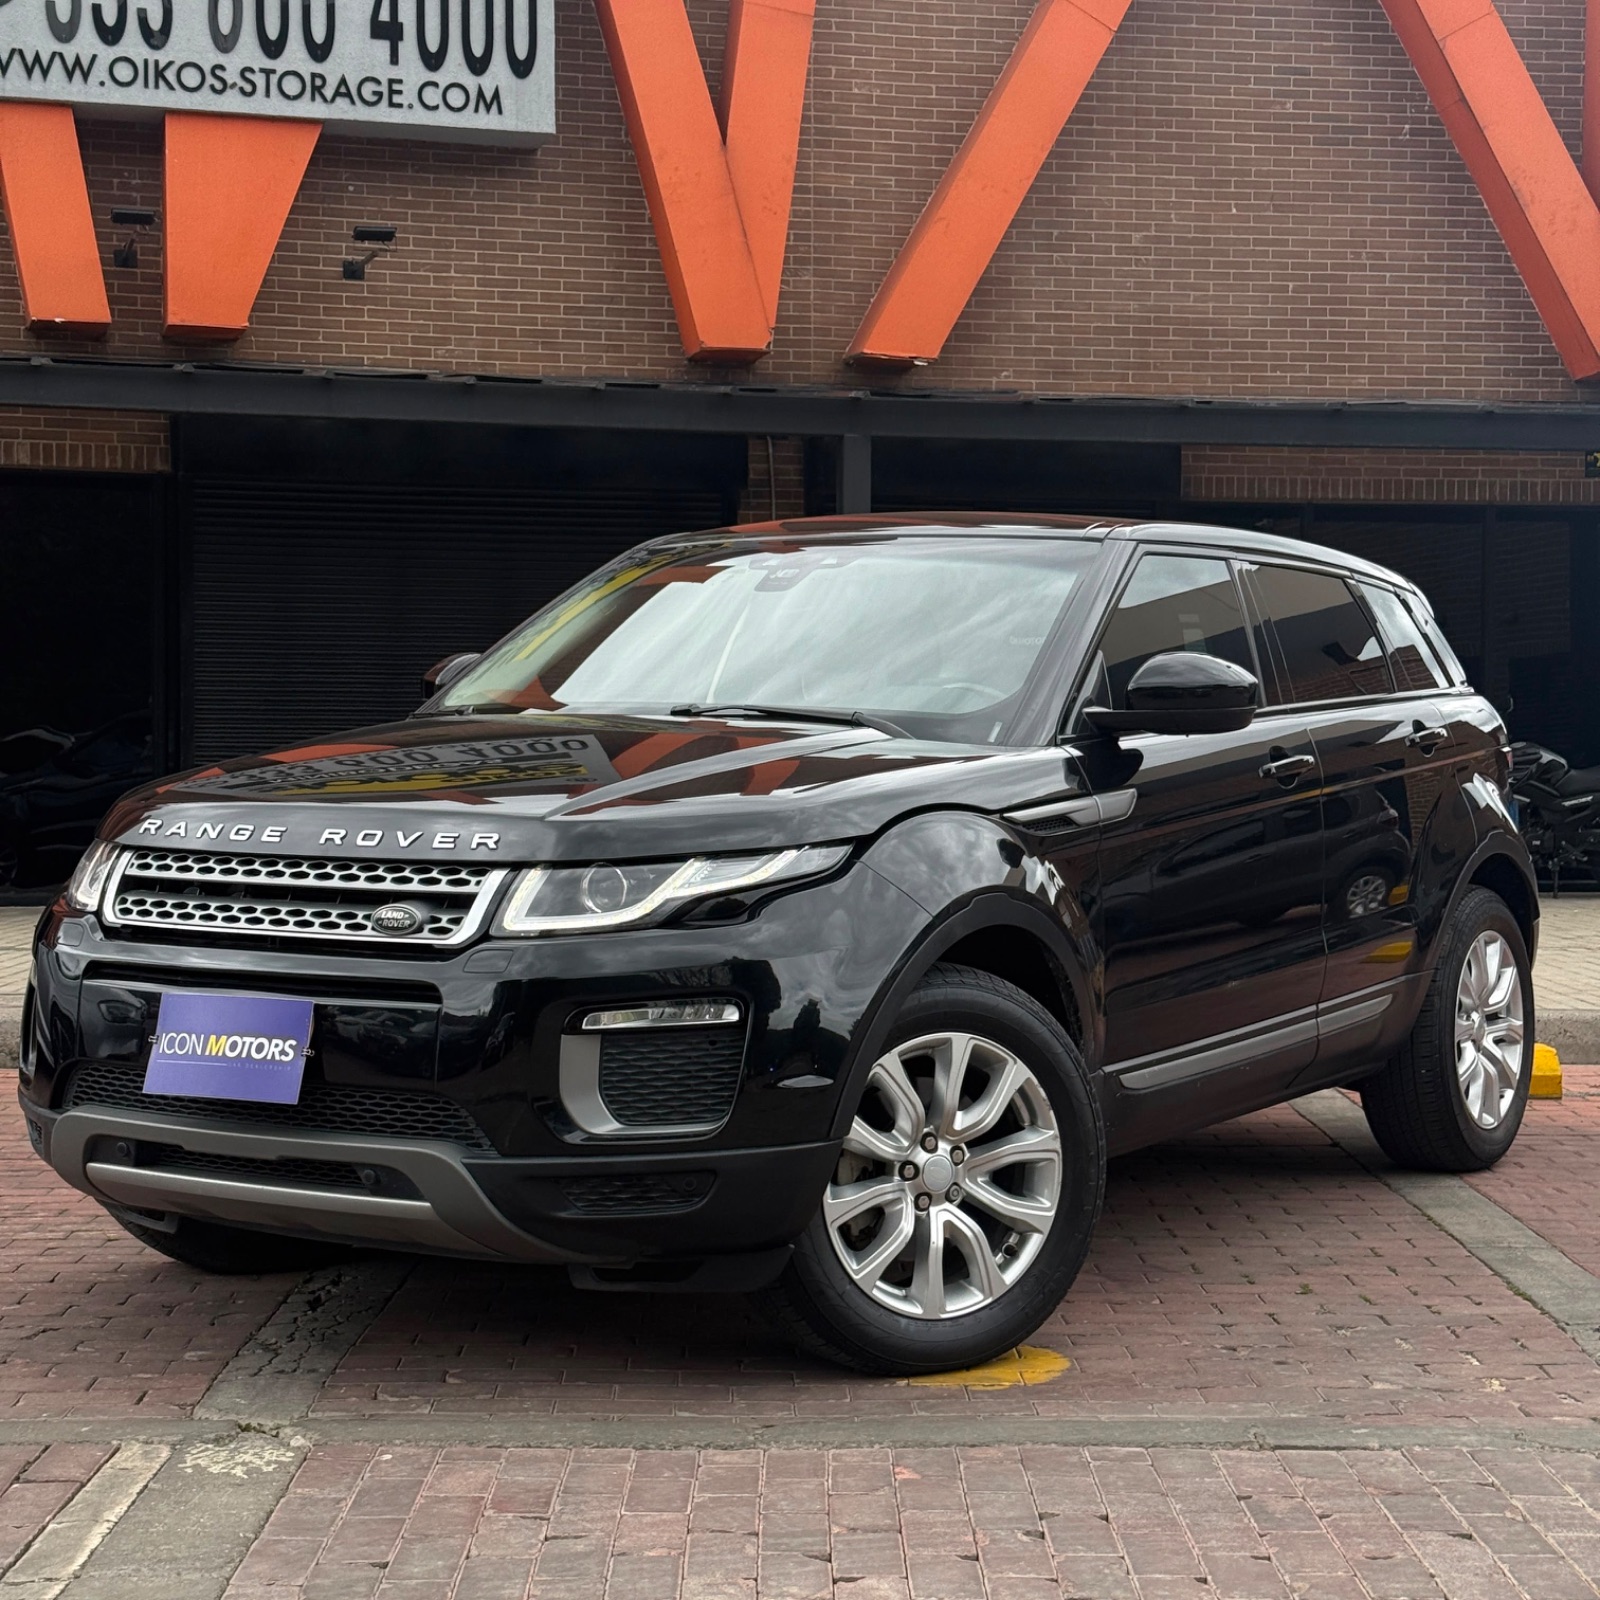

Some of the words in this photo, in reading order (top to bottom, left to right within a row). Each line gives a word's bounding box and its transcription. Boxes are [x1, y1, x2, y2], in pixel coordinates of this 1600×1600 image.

[138, 819, 288, 843] RANGE
[318, 828, 501, 850] ROVER
[381, 911, 405, 919] LAND
[382, 919, 411, 928] ROVER
[159, 1032, 204, 1055] ICON
[205, 1034, 297, 1062] MOTORS
